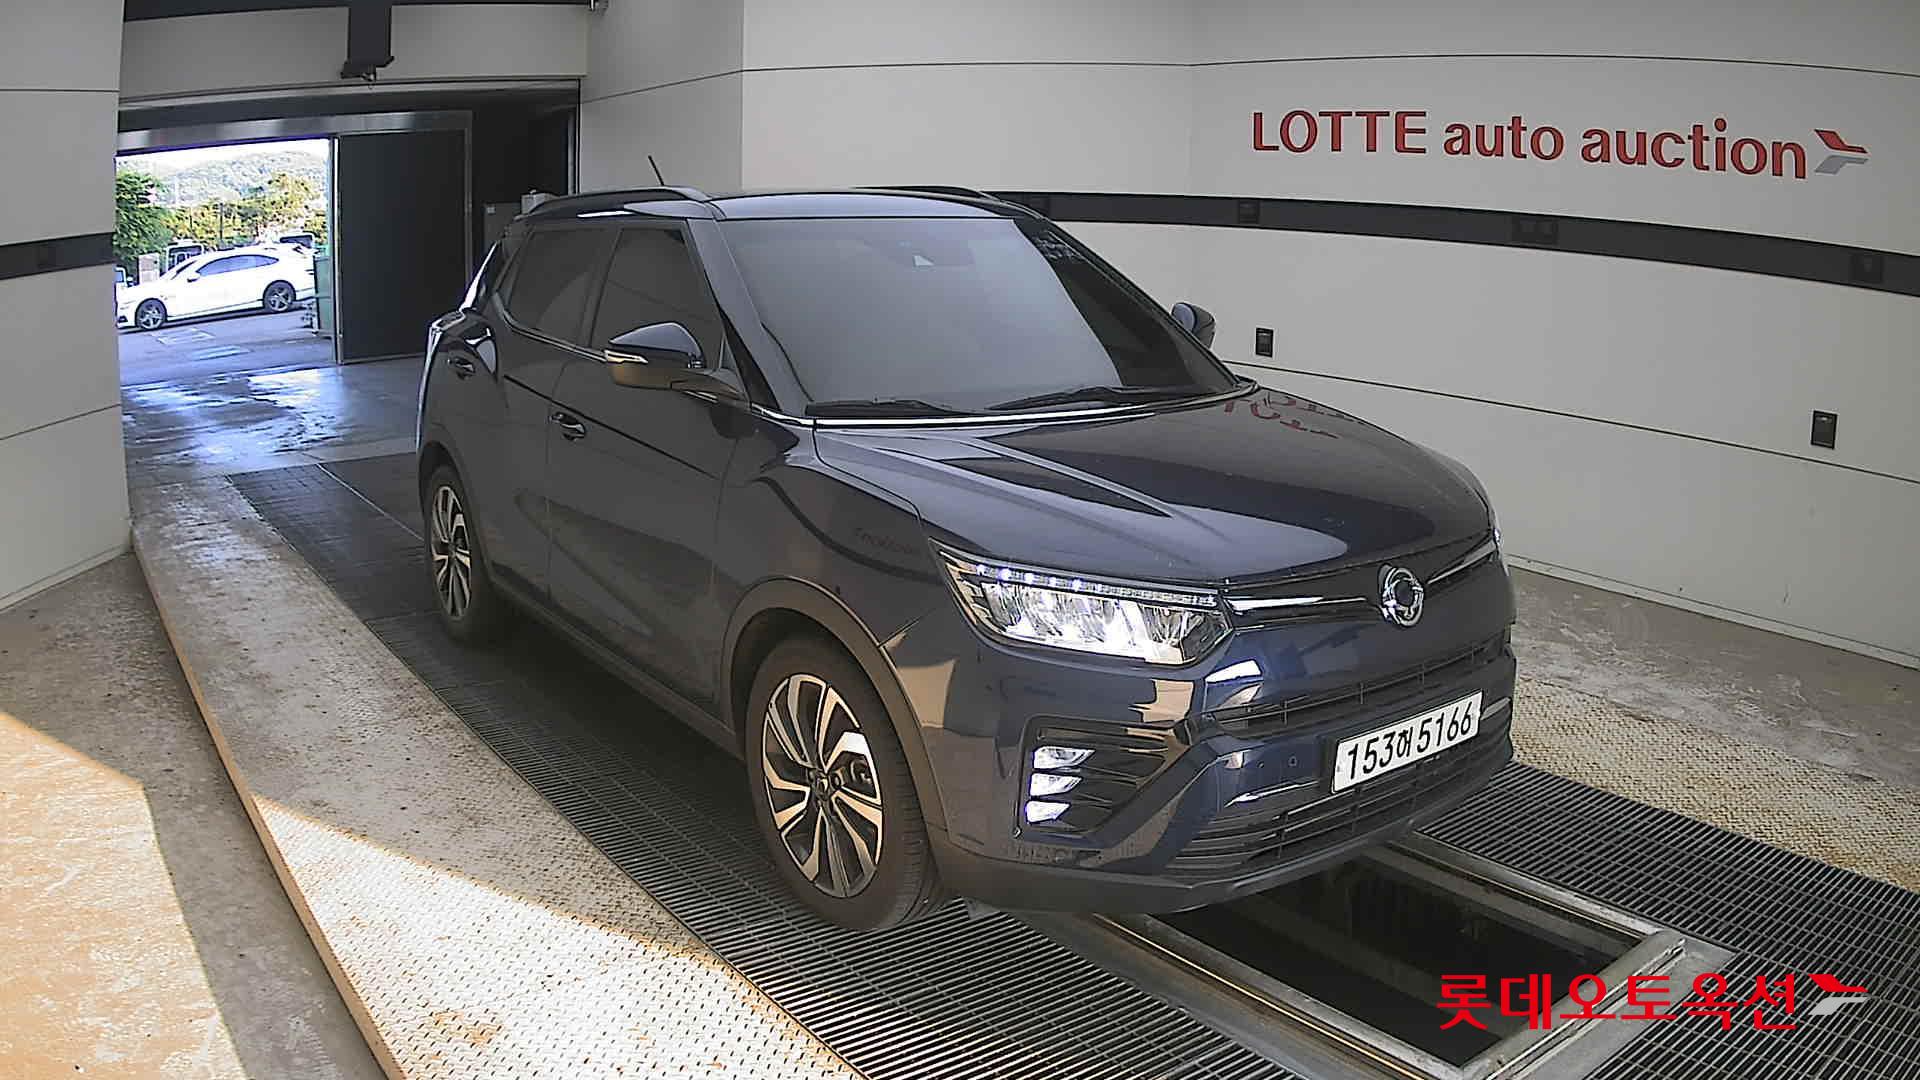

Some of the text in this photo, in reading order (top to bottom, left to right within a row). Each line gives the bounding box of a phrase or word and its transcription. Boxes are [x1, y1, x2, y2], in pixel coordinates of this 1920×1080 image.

[1252, 110, 1806, 179] LOTTE auto auction
